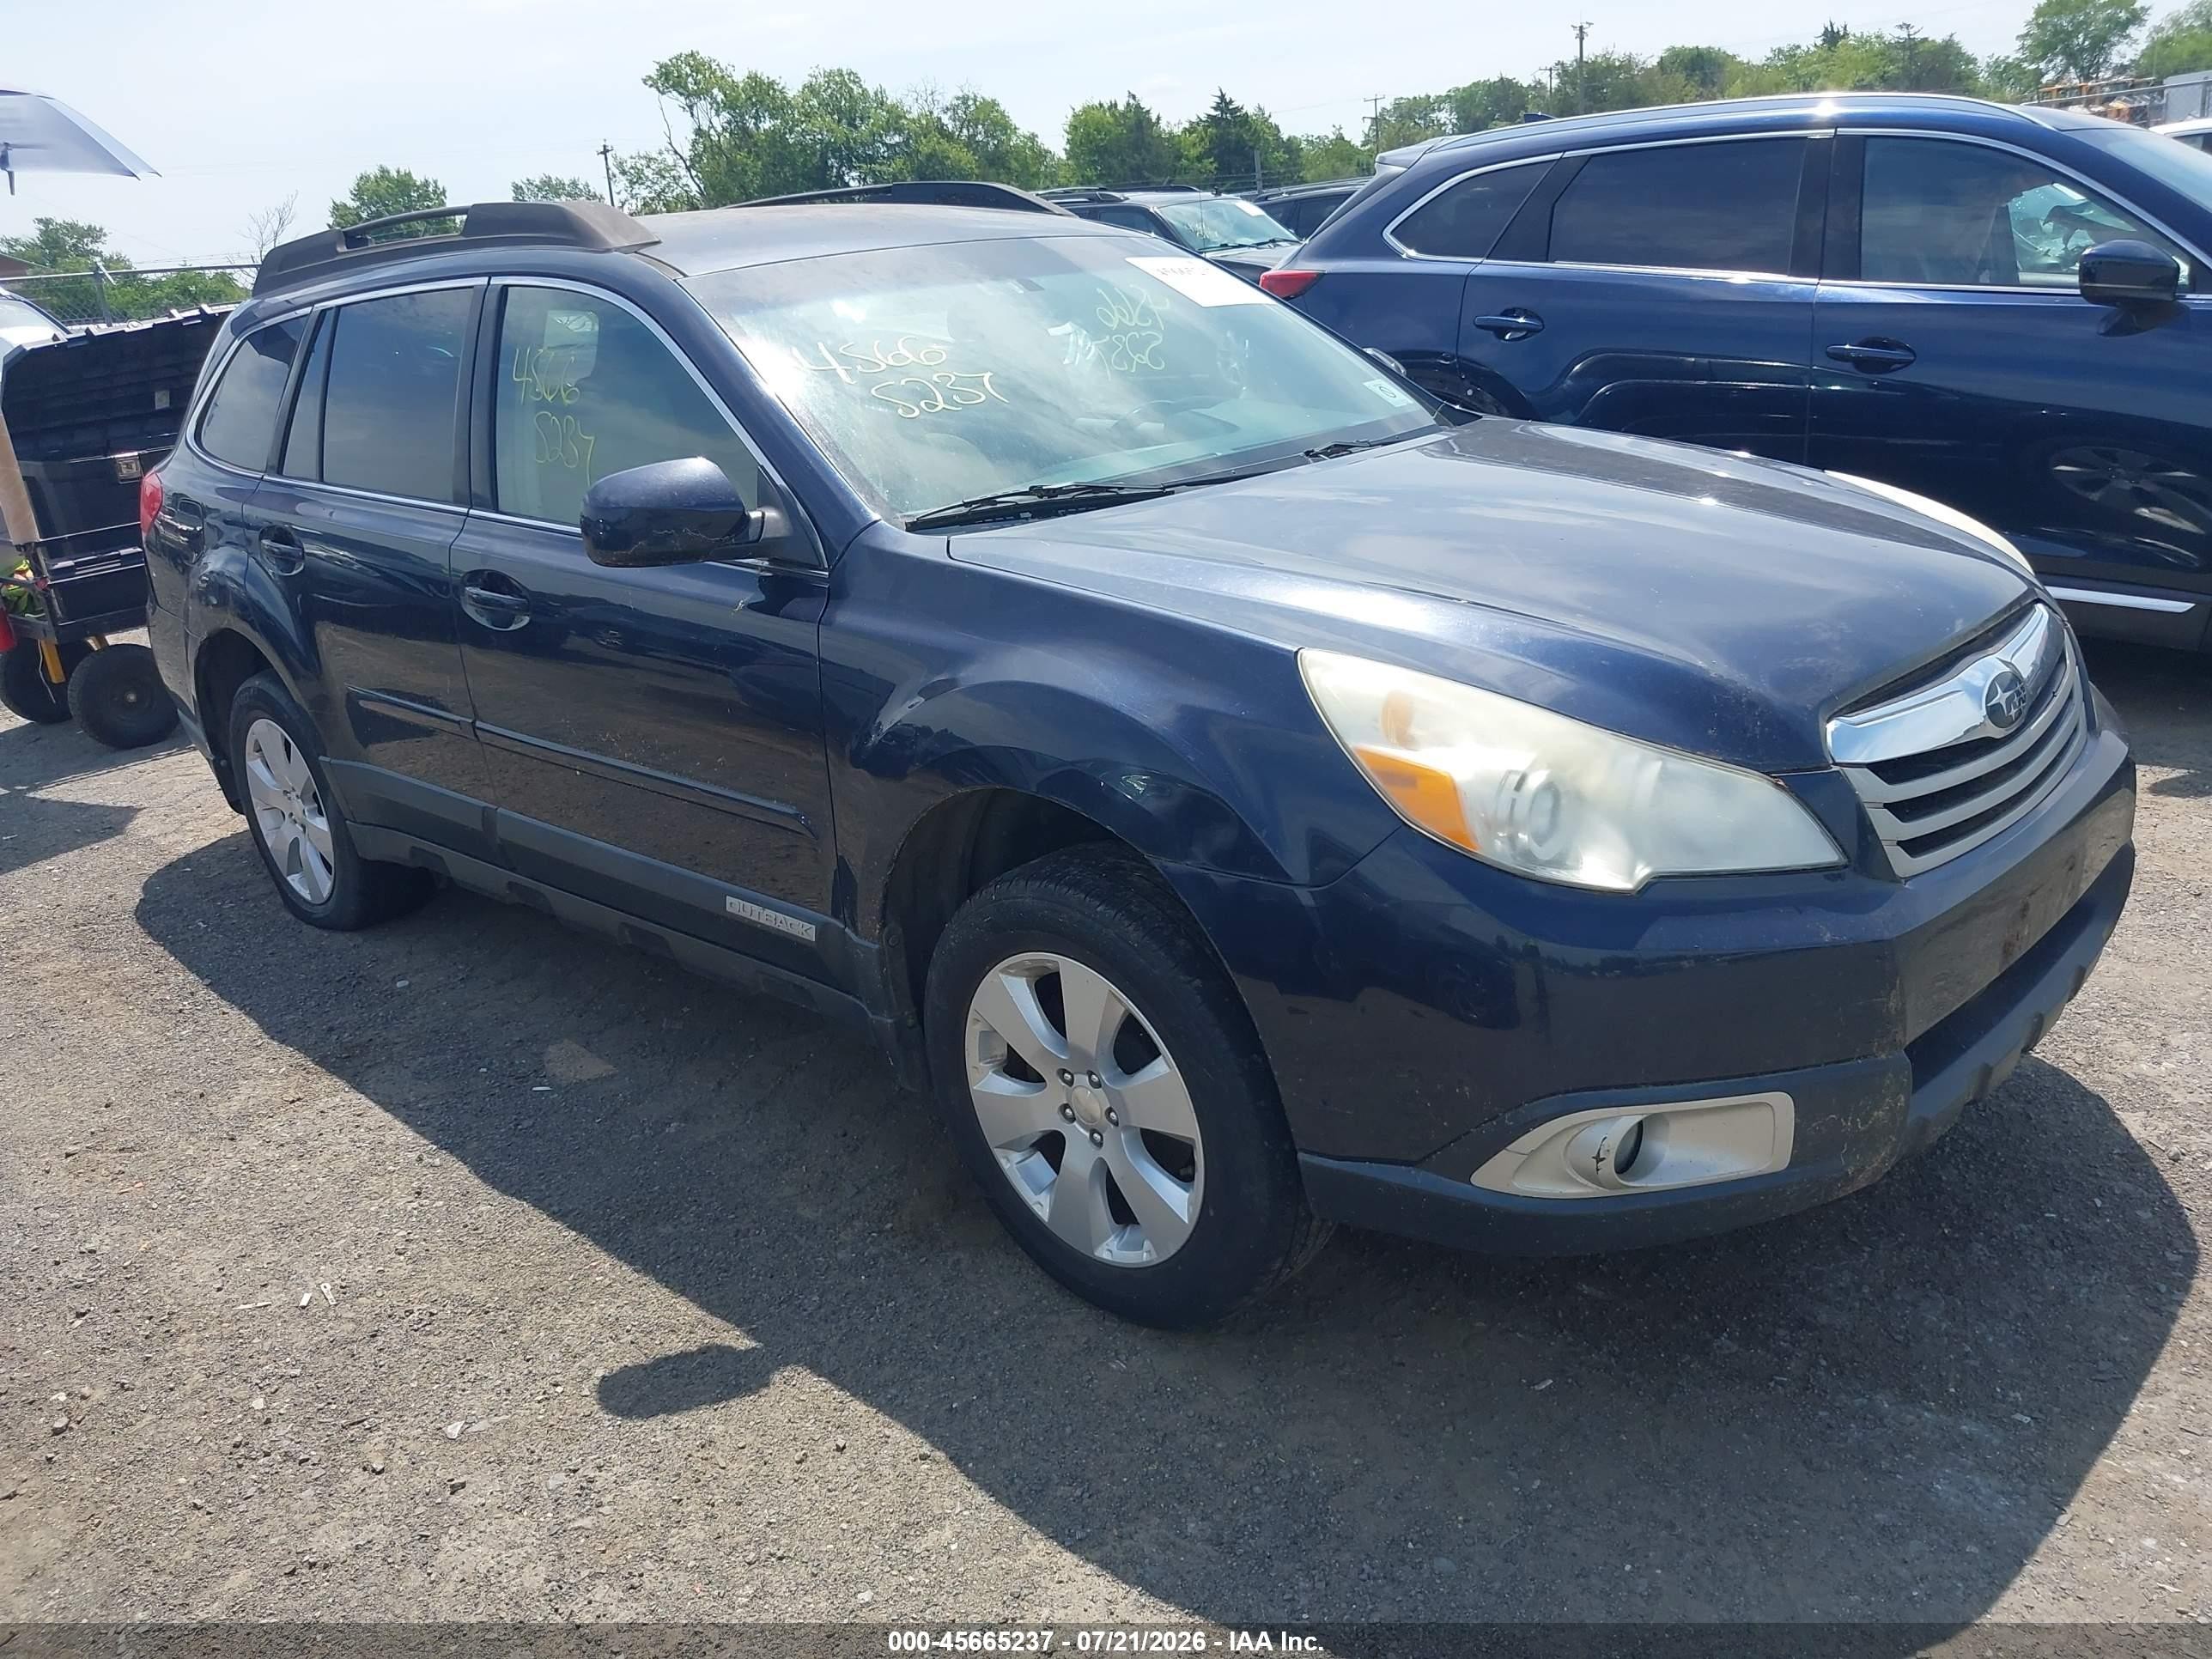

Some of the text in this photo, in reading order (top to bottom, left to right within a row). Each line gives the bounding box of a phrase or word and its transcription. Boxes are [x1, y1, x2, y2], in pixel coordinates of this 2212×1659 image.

[789, 335, 947, 385] 4566
[870, 370, 1010, 419] 5237
[533, 410, 596, 487] 5237
[727, 898, 812, 938] OUTBACK
